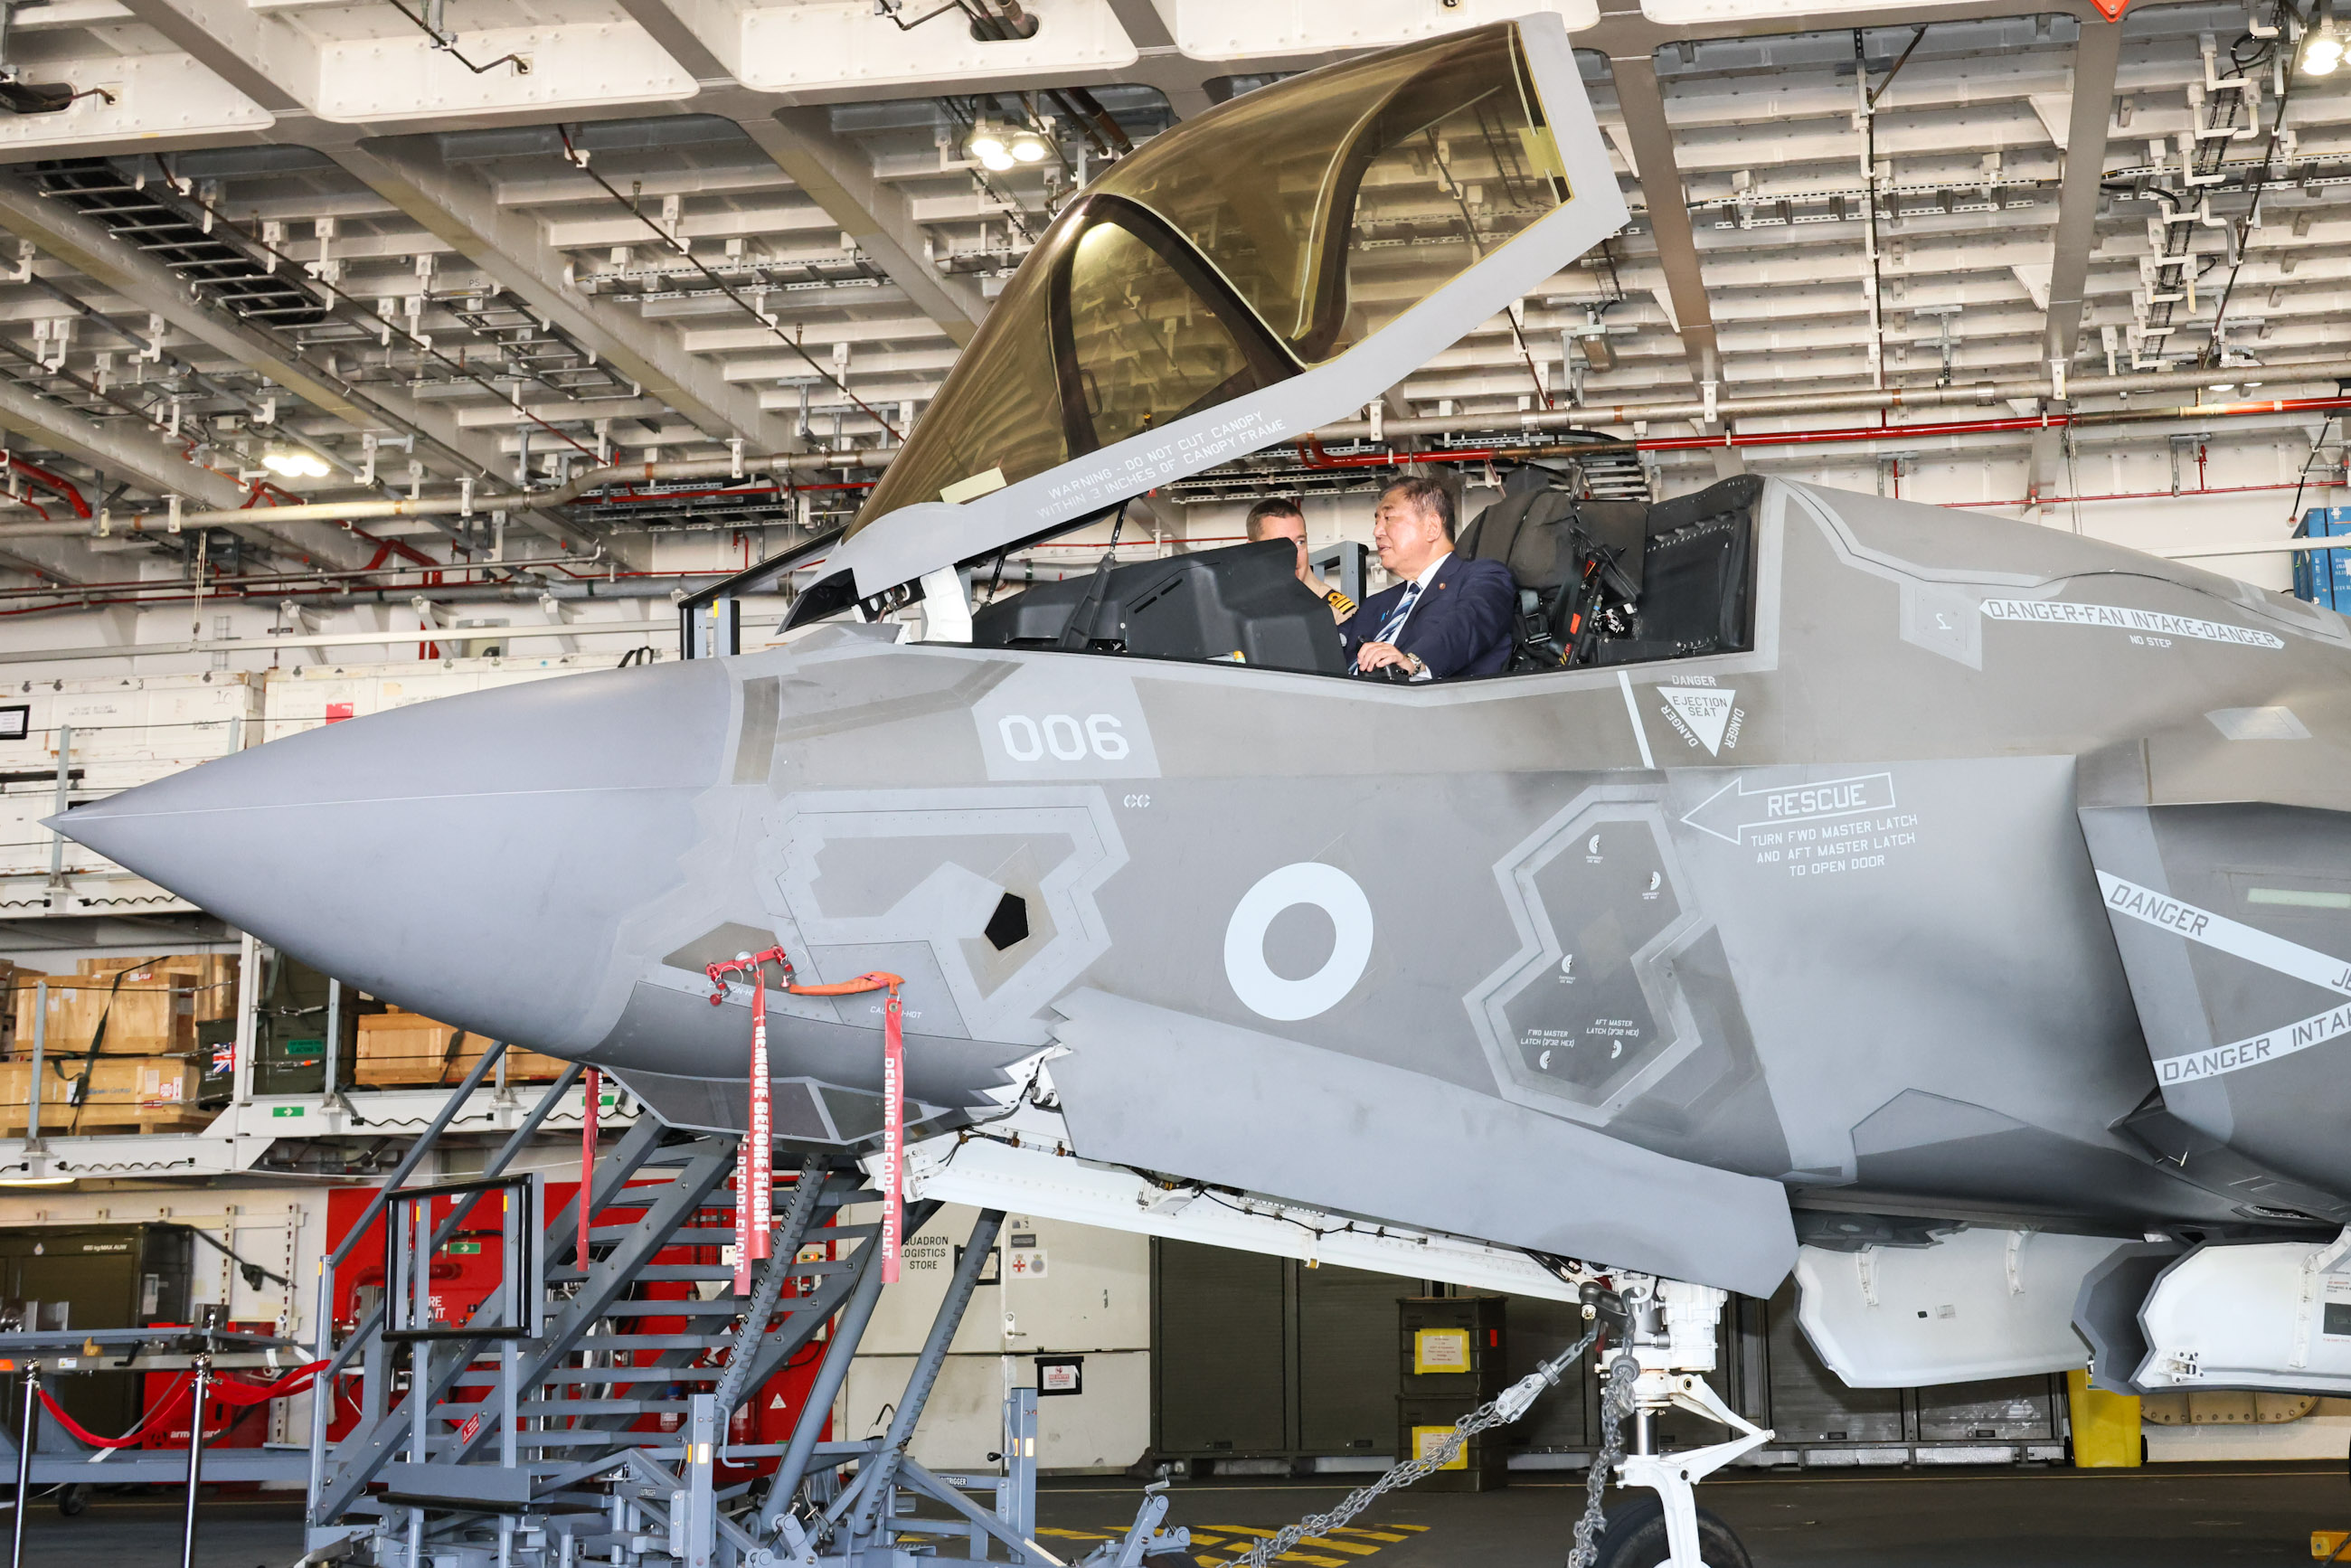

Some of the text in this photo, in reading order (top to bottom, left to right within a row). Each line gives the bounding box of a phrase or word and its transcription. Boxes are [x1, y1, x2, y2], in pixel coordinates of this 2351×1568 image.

[1036, 419, 1287, 519] WITHIN 3 INCHES OF CANOPY FRAME
[1048, 468, 1113, 500] WARNING
[1125, 456, 1144, 471] DO
[1147, 444, 1173, 462] NOT
[1177, 432, 1204, 450] CUT
[1211, 410, 1263, 439] CANOPY
[1987, 600, 2277, 647] DANGER-FAN INTAKE-DANGER
[2129, 634, 2173, 648] NO STEP
[1671, 675, 1717, 686] DANGER
[1672, 695, 1728, 707] EJECTION
[1688, 707, 1716, 717] SEAT
[997, 713, 1129, 761] 006
[1660, 704, 1699, 748] DANGER
[1723, 707, 1745, 749] DANGER
[1768, 783, 1867, 817] RESCUE
[1751, 814, 1918, 847] TURN FWD MASTER LATCH
[1757, 832, 1916, 864] AND AFT MASTER LATCH
[1789, 855, 1885, 877] TO OPEN DOOR
[2109, 883, 2209, 936] DANGER
[1544, 1030, 1569, 1038] MASTER
[2163, 1037, 2271, 1082] DANGER
[752, 1101, 770, 1169] BEFORE
[752, 1170, 771, 1234] FLIGHT
[909, 1261, 938, 1270] STORE
